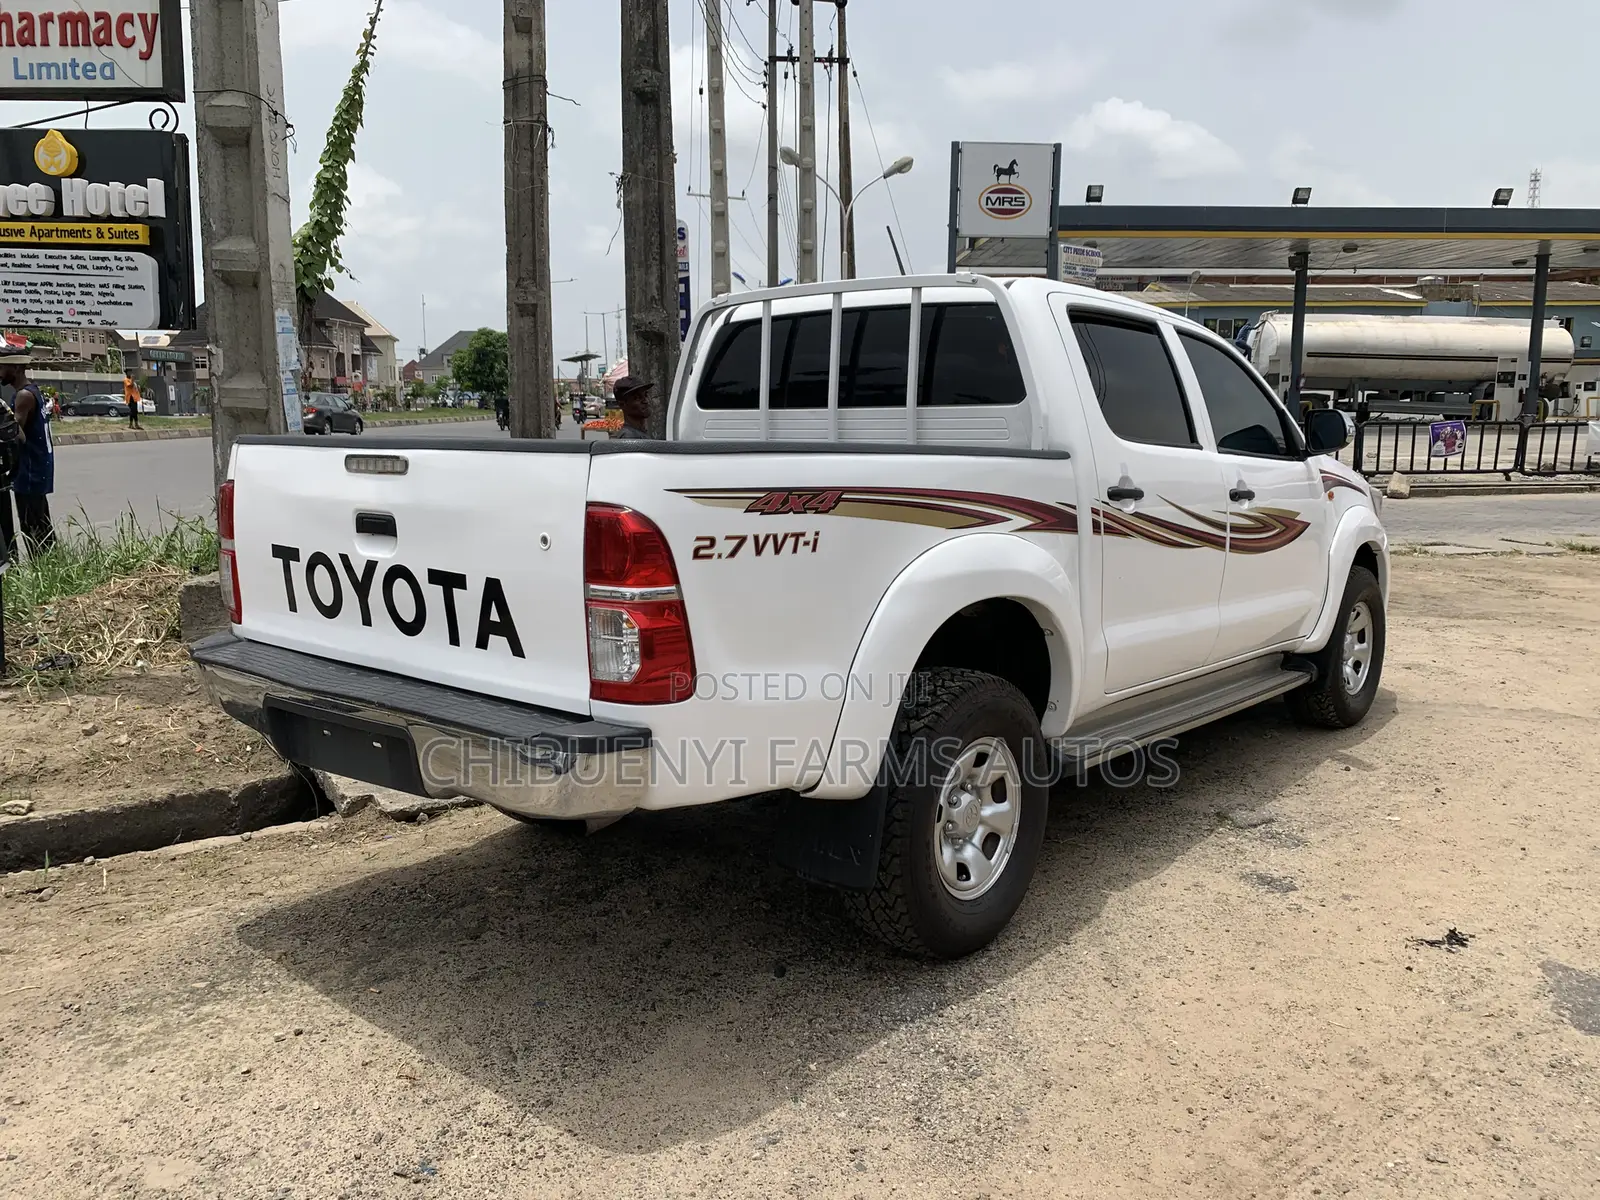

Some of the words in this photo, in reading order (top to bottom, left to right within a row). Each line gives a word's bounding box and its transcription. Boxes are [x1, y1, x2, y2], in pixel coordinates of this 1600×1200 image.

[12, 57, 116, 81] Limited
[61, 177, 166, 218] Hotel
[985, 195, 1026, 207] MRS
[29, 225, 92, 241] Apartments
[96, 227, 105, 240] &
[107, 227, 140, 240] Suites
[1063, 246, 1073, 255] CITY
[1073, 248, 1086, 256] PRIDE
[744, 490, 843, 515] 4x4
[692, 535, 748, 561] 2.7
[271, 543, 526, 659] TOYOTA
